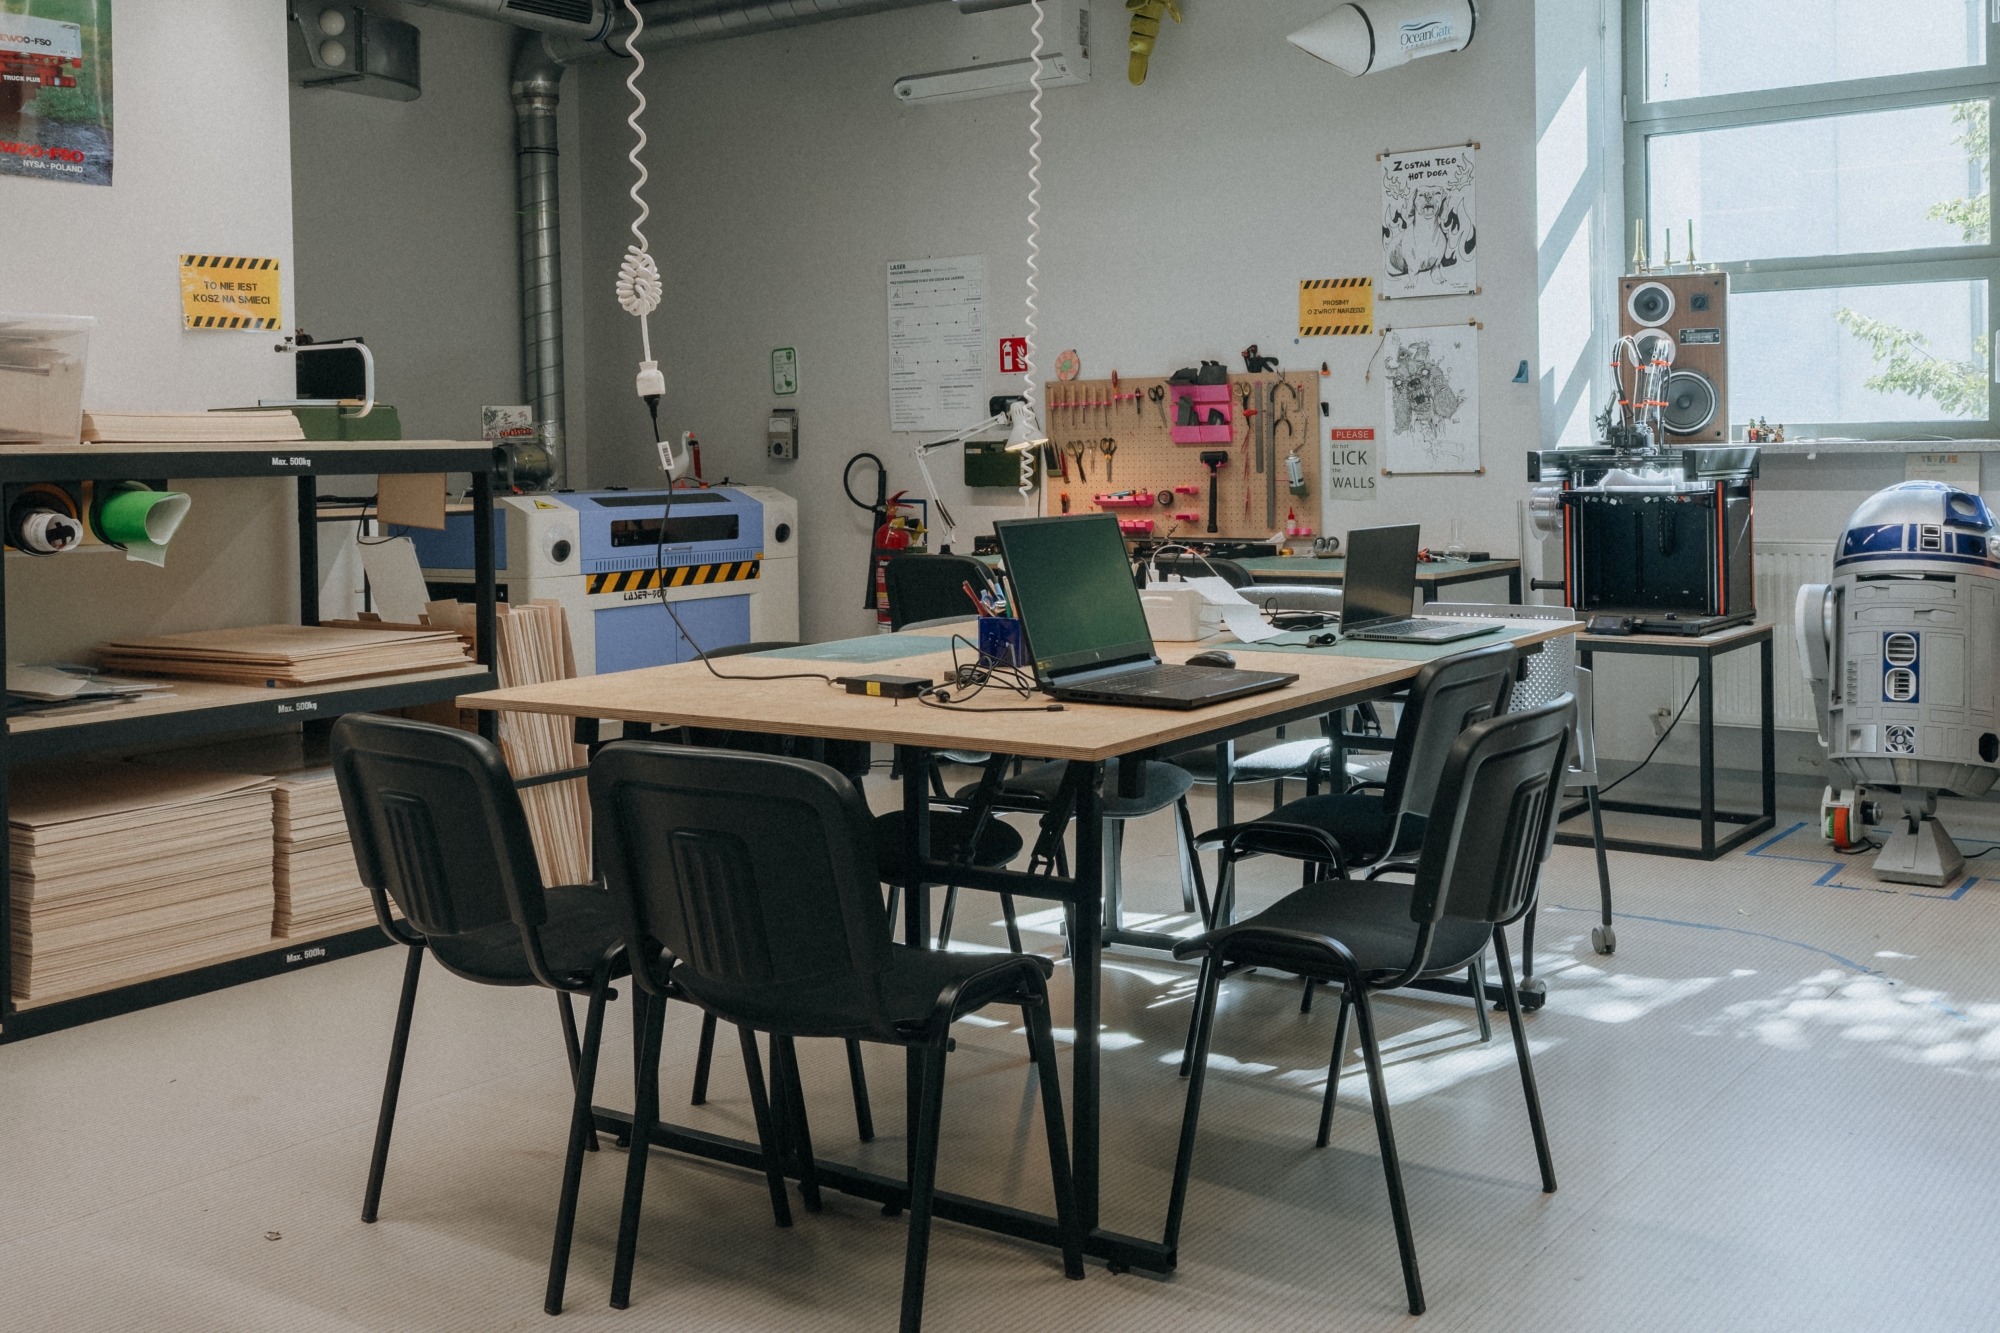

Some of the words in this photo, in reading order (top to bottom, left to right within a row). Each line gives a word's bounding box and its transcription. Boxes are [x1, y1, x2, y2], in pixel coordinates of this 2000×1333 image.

[1401, 26, 1453, 45] OceanGate
[3, 74, 25, 82] TRUCK
[26, 75, 41, 83] PLUS
[0, 140, 85, 163] WOO-FSO
[1393, 160, 1431, 172] ZOSTAW
[1435, 157, 1457, 166] TEGO
[1408, 171, 1424, 181] HOT
[1427, 170, 1448, 178] DOGA
[204, 281, 217, 290] TO
[220, 282, 234, 291] NIE
[237, 283, 257, 292] JEST
[193, 294, 219, 303] KOSZ
[222, 295, 235, 304] NA
[1336, 430, 1369, 438] PLEASE
[272, 457, 288, 466] Max.
[290, 456, 311, 467] 500kg
[1333, 450, 1367, 465] LICK
[1332, 476, 1375, 489] WALLS
[278, 704, 295, 714] Max.
[296, 701, 317, 710] 500kg
[287, 953, 303, 963] Max.
[304, 947, 326, 959] 500kg
